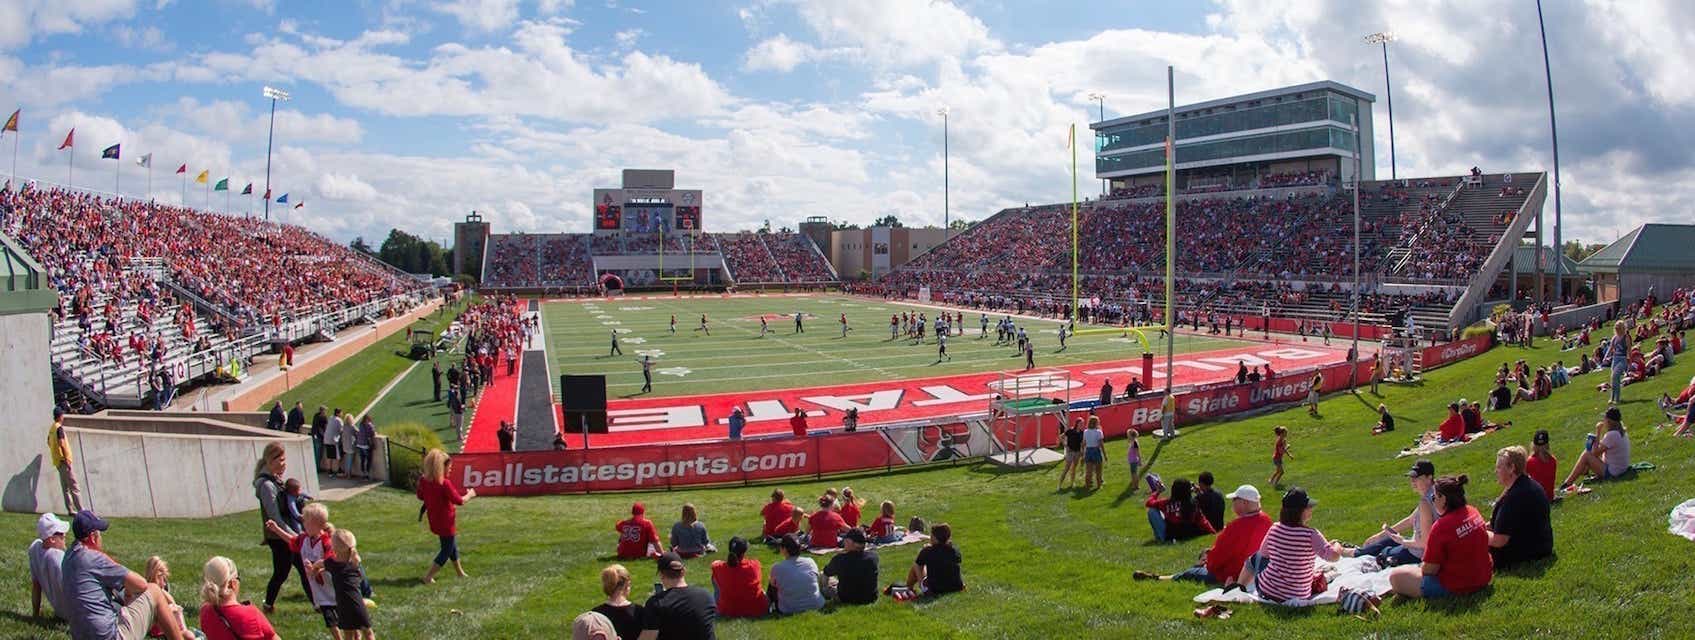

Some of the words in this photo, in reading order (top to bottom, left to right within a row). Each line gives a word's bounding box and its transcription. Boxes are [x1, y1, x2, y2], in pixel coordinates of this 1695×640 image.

[1083, 349, 1331, 379] BALL
[606, 376, 1085, 431] STATE
[1188, 393, 1239, 415] State
[1250, 378, 1313, 403] Universi
[463, 451, 806, 488] ballstatesports.com
